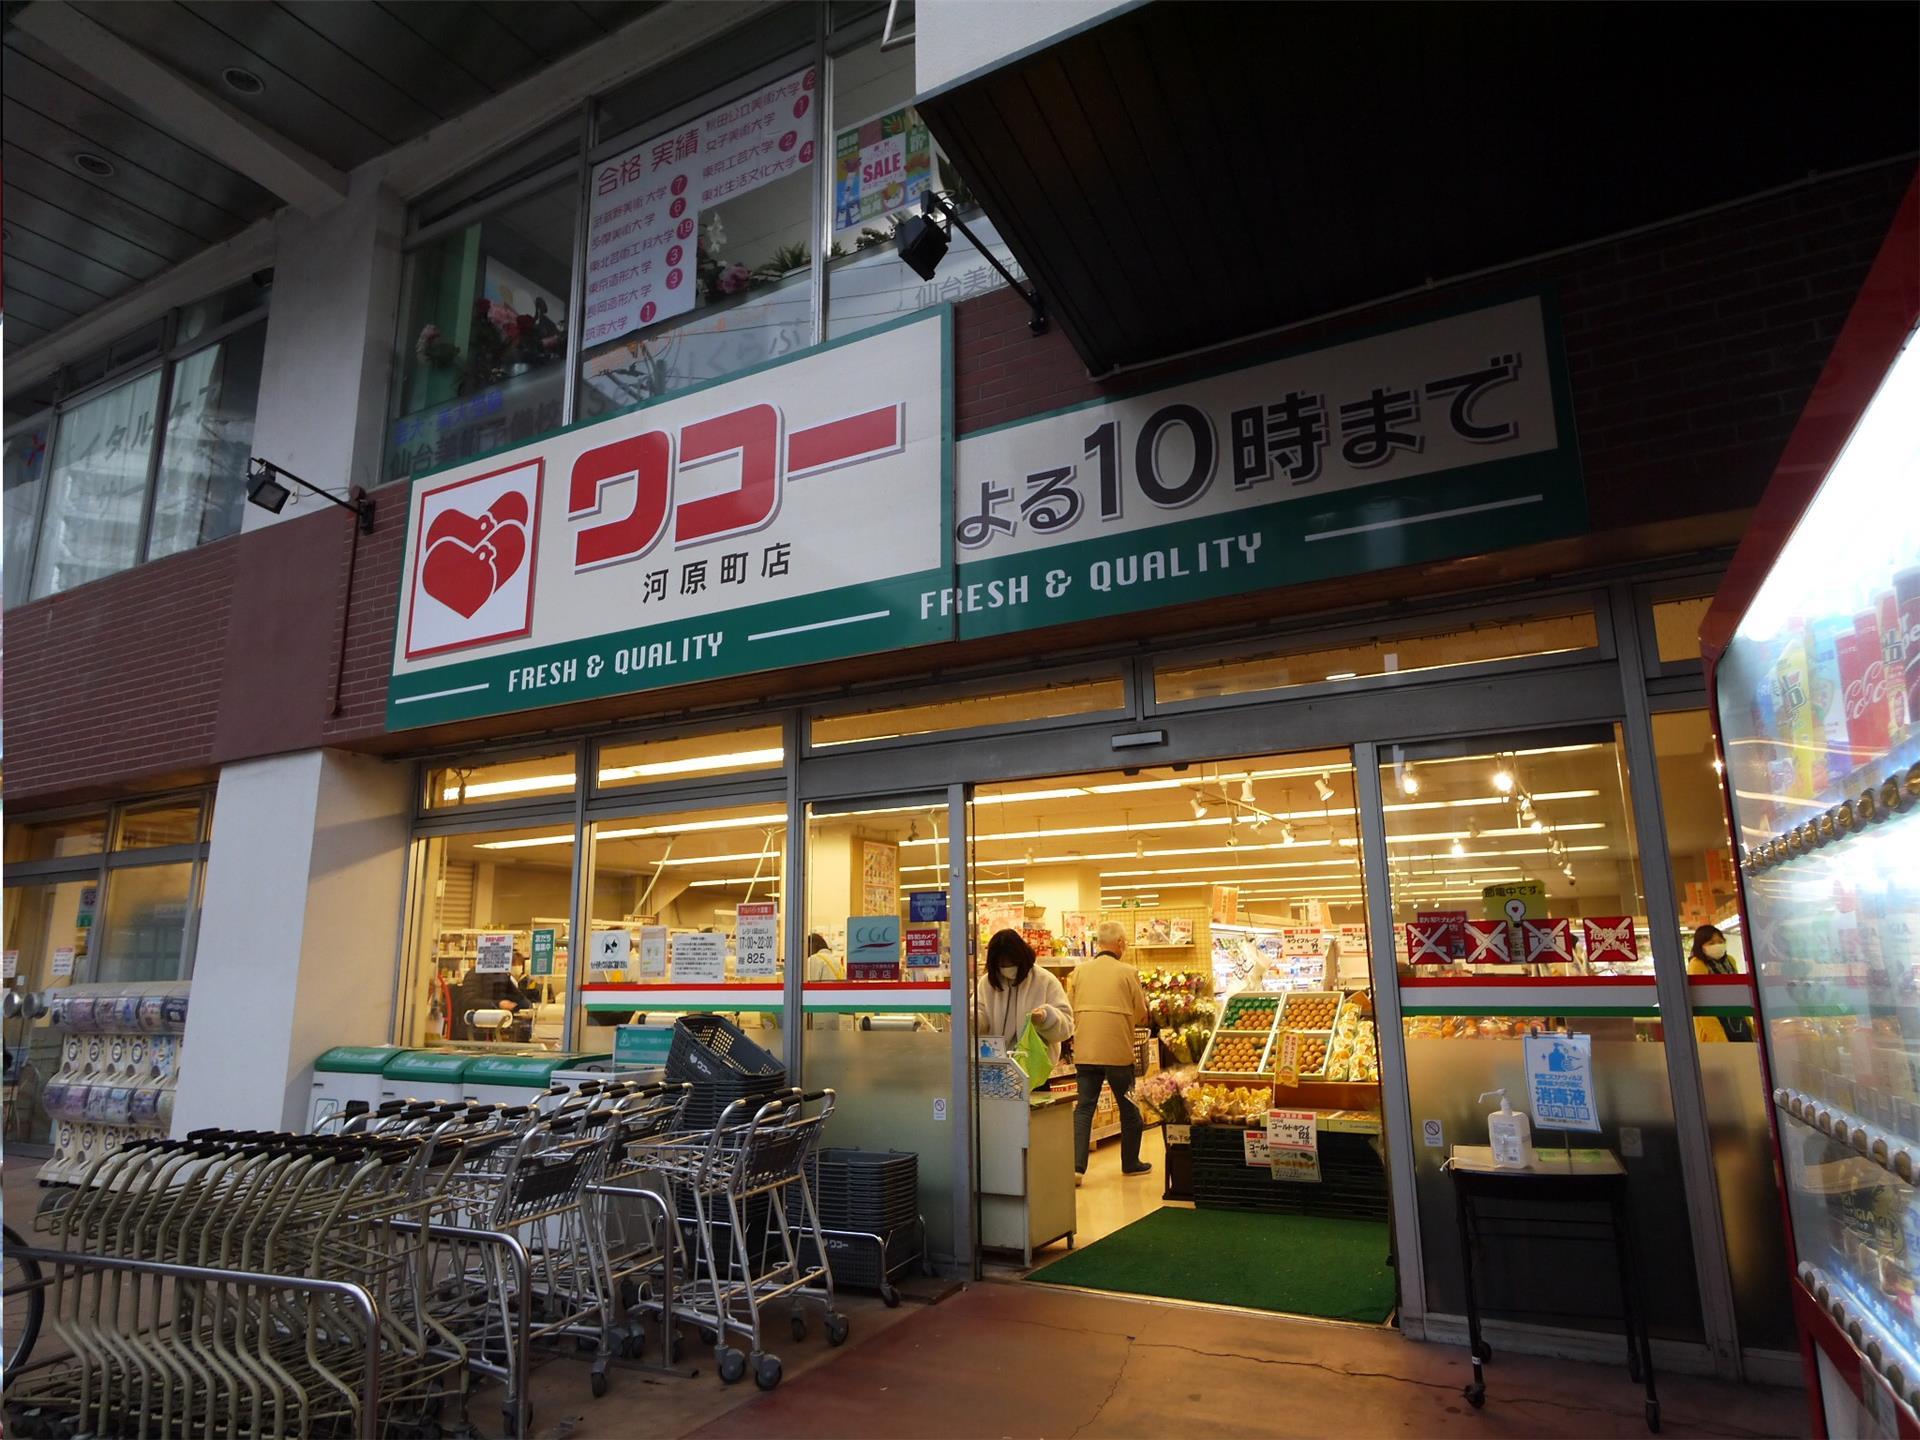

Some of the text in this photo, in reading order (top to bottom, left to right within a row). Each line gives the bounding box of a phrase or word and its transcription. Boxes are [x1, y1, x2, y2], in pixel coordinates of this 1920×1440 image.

[704, 112, 776, 153] 女子美術大学
[598, 128, 700, 196] 合格 実績
[702, 154, 798, 203] 東北生活文化大学
[863, 152, 901, 183] SALE
[592, 185, 668, 229] 武蔵野美術大学
[591, 212, 656, 251] 多摩美術大学
[588, 260, 653, 294] 東京造形大学
[585, 315, 628, 341] 筑波大学
[956, 352, 1523, 550] よる10時まで
[568, 402, 906, 575] ワコー
[642, 542, 792, 604] 河原町店
[920, 531, 1263, 620] FRESH & QUALITY
[507, 631, 724, 693] FRESH & QUALITY
[855, 926, 894, 943] CGC
[746, 952, 766, 964] 825
[855, 969, 892, 979] 取扱店
[907, 956, 938, 966] SEOM
[1535, 1086, 1587, 1106] 消毒液
